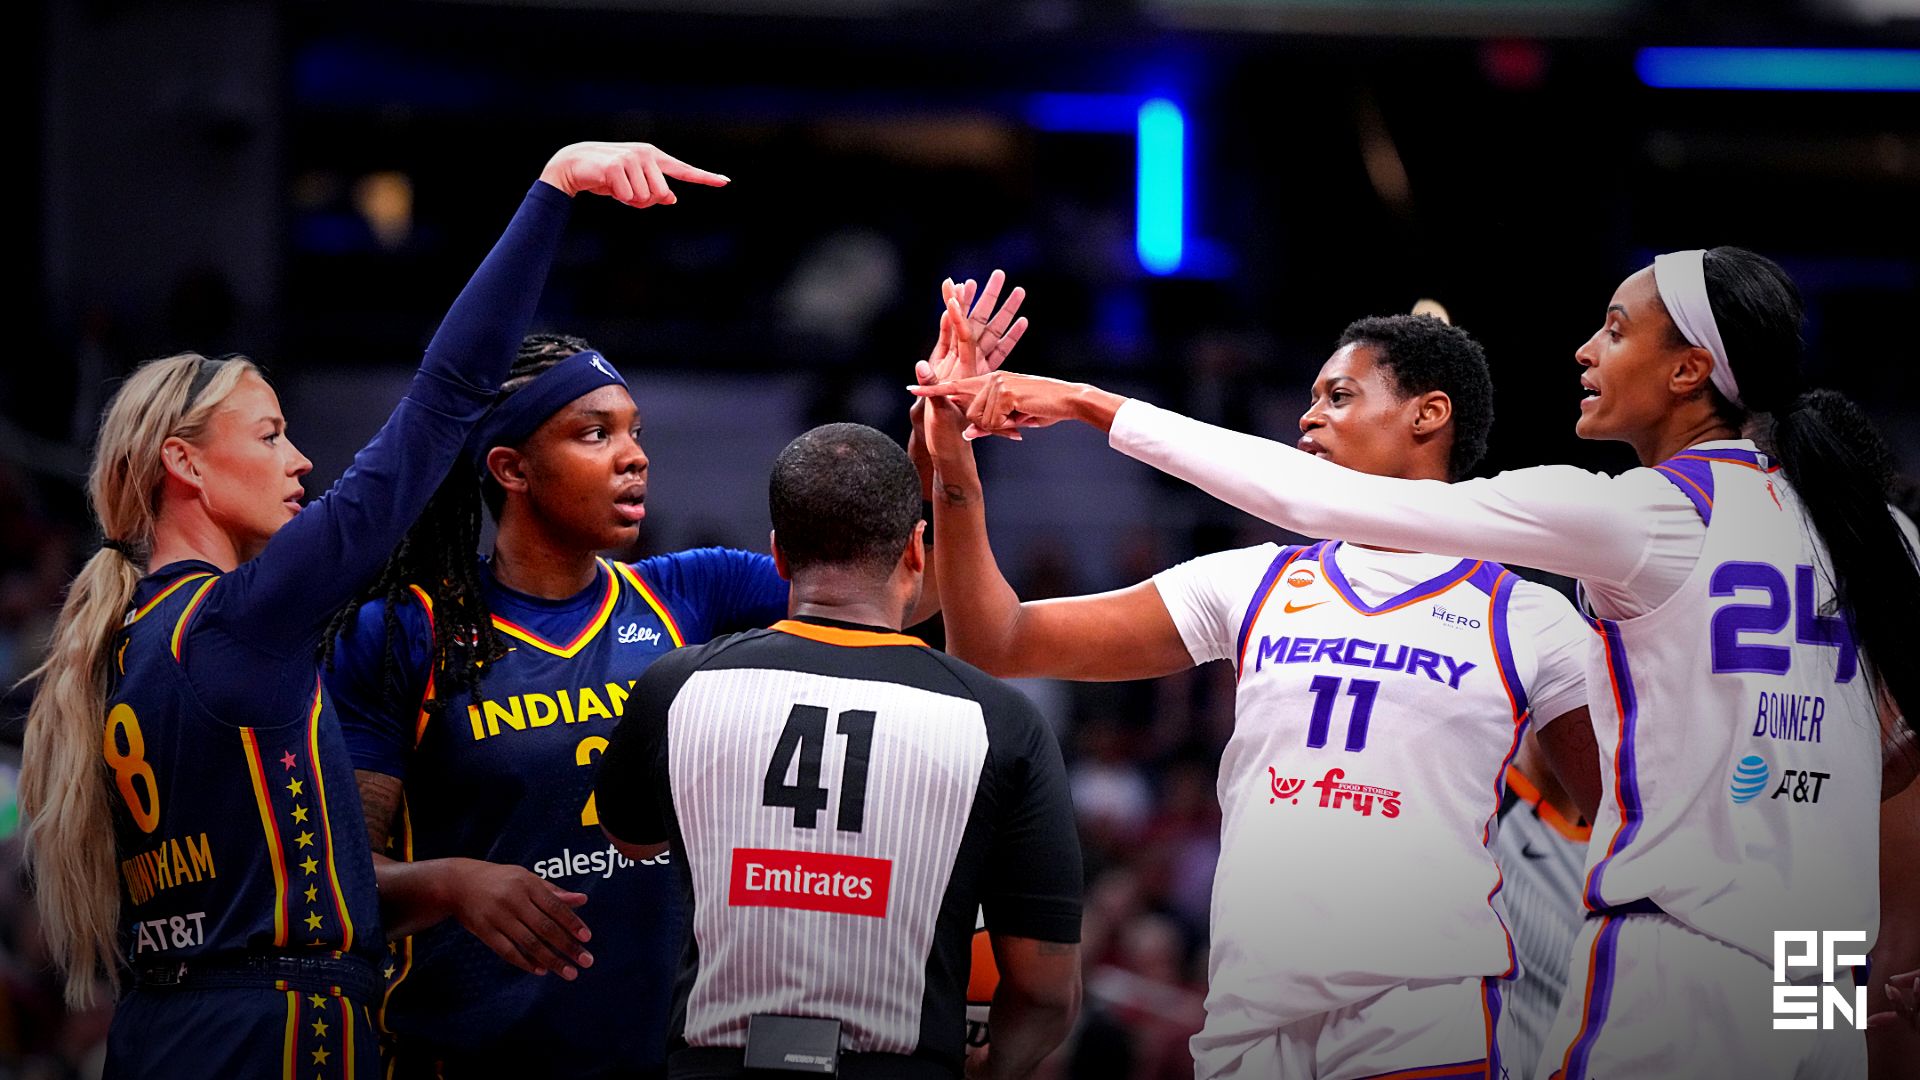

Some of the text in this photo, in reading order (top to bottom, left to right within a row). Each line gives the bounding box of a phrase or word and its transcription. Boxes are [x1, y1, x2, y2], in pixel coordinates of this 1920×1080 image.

[617, 622, 662, 646] Lilly
[1431, 606, 1481, 629] HERO
[1709, 560, 1858, 683] 24
[1255, 634, 1478, 690] MERCURY
[467, 680, 637, 741] INDIAN
[1306, 674, 1381, 752] 11
[1752, 691, 1826, 743] BONNER
[103, 703, 160, 833] 8
[762, 703, 878, 834] 41
[1312, 768, 1402, 818] fry's
[1339, 783, 1394, 797] FOOD STORES
[1771, 769, 1831, 804] AT&T
[533, 843, 671, 880] salesfoe
[744, 862, 873, 900] Emirates
[136, 911, 206, 954] AT&T
